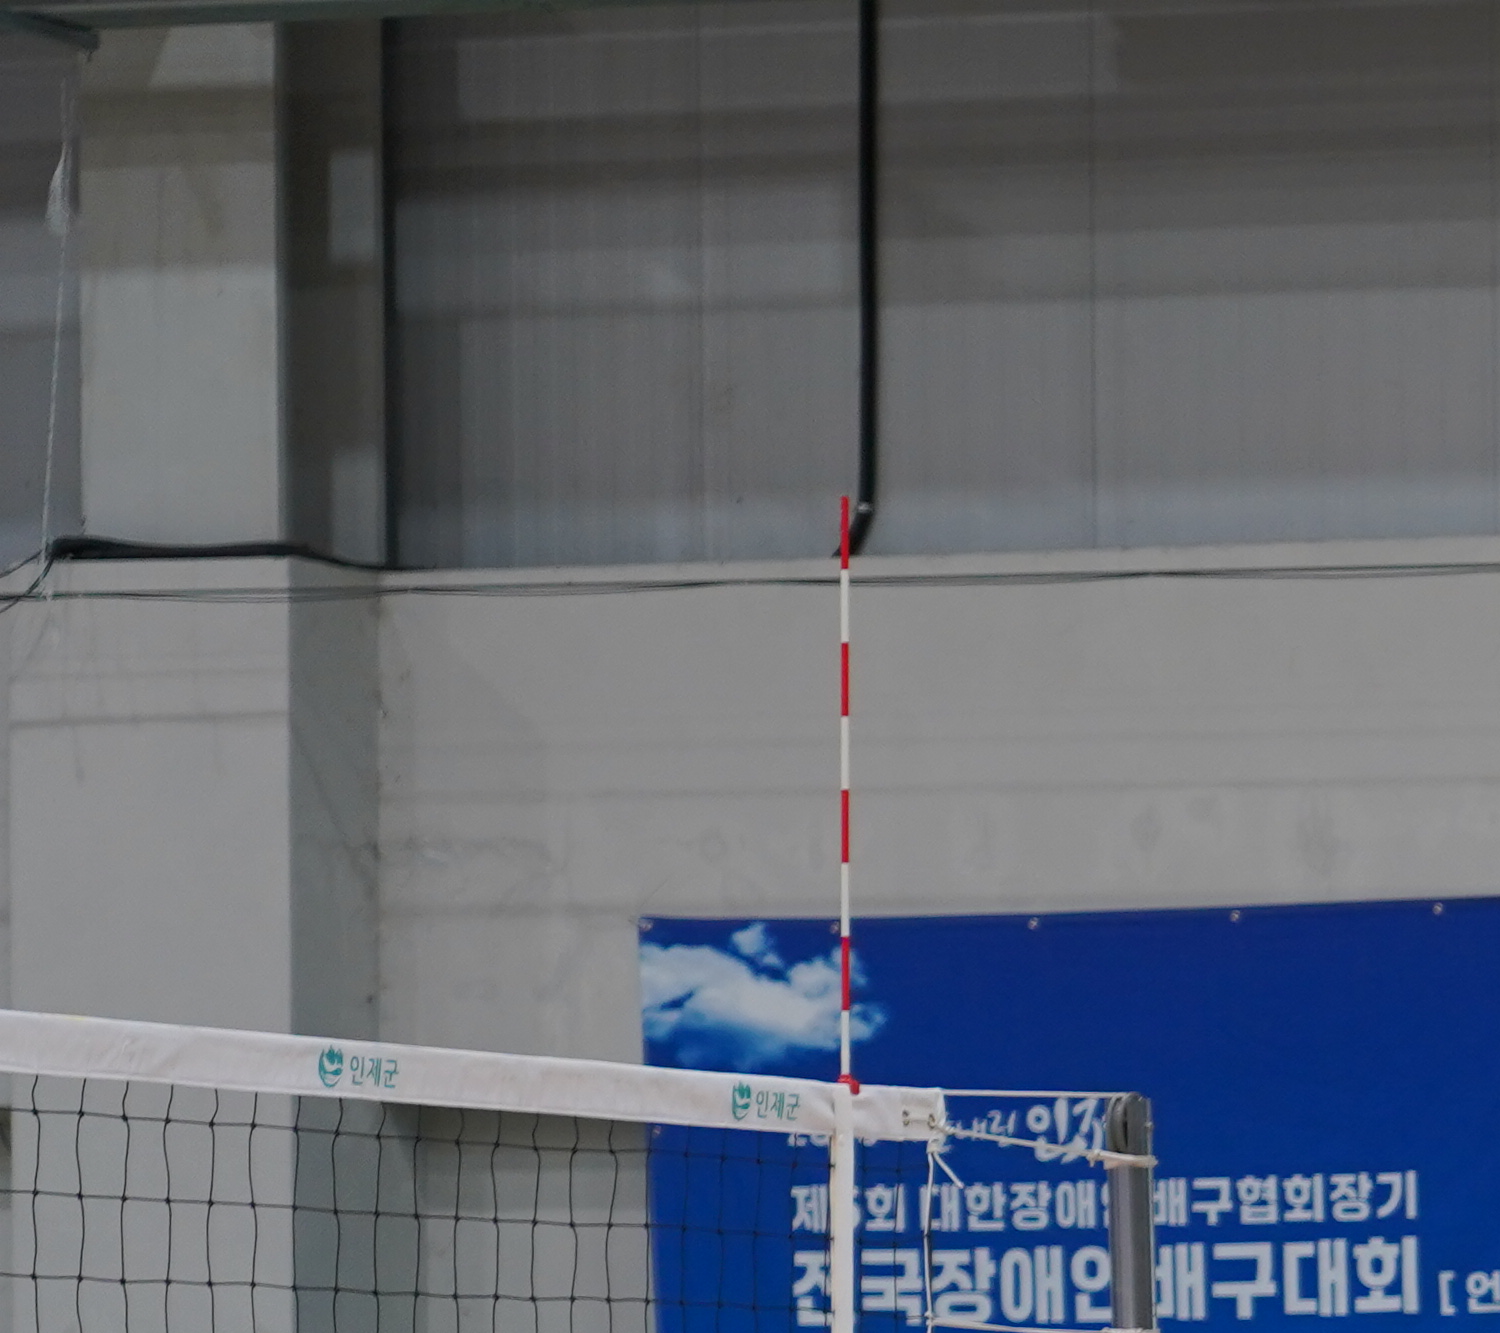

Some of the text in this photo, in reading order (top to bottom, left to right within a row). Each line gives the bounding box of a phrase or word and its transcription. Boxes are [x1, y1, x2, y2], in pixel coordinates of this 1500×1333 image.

[350, 1055, 400, 1089] 인제군
[756, 1091, 801, 1122] 인제군
[791, 1170, 1418, 1234] 제회 대한장애배구협회장기
